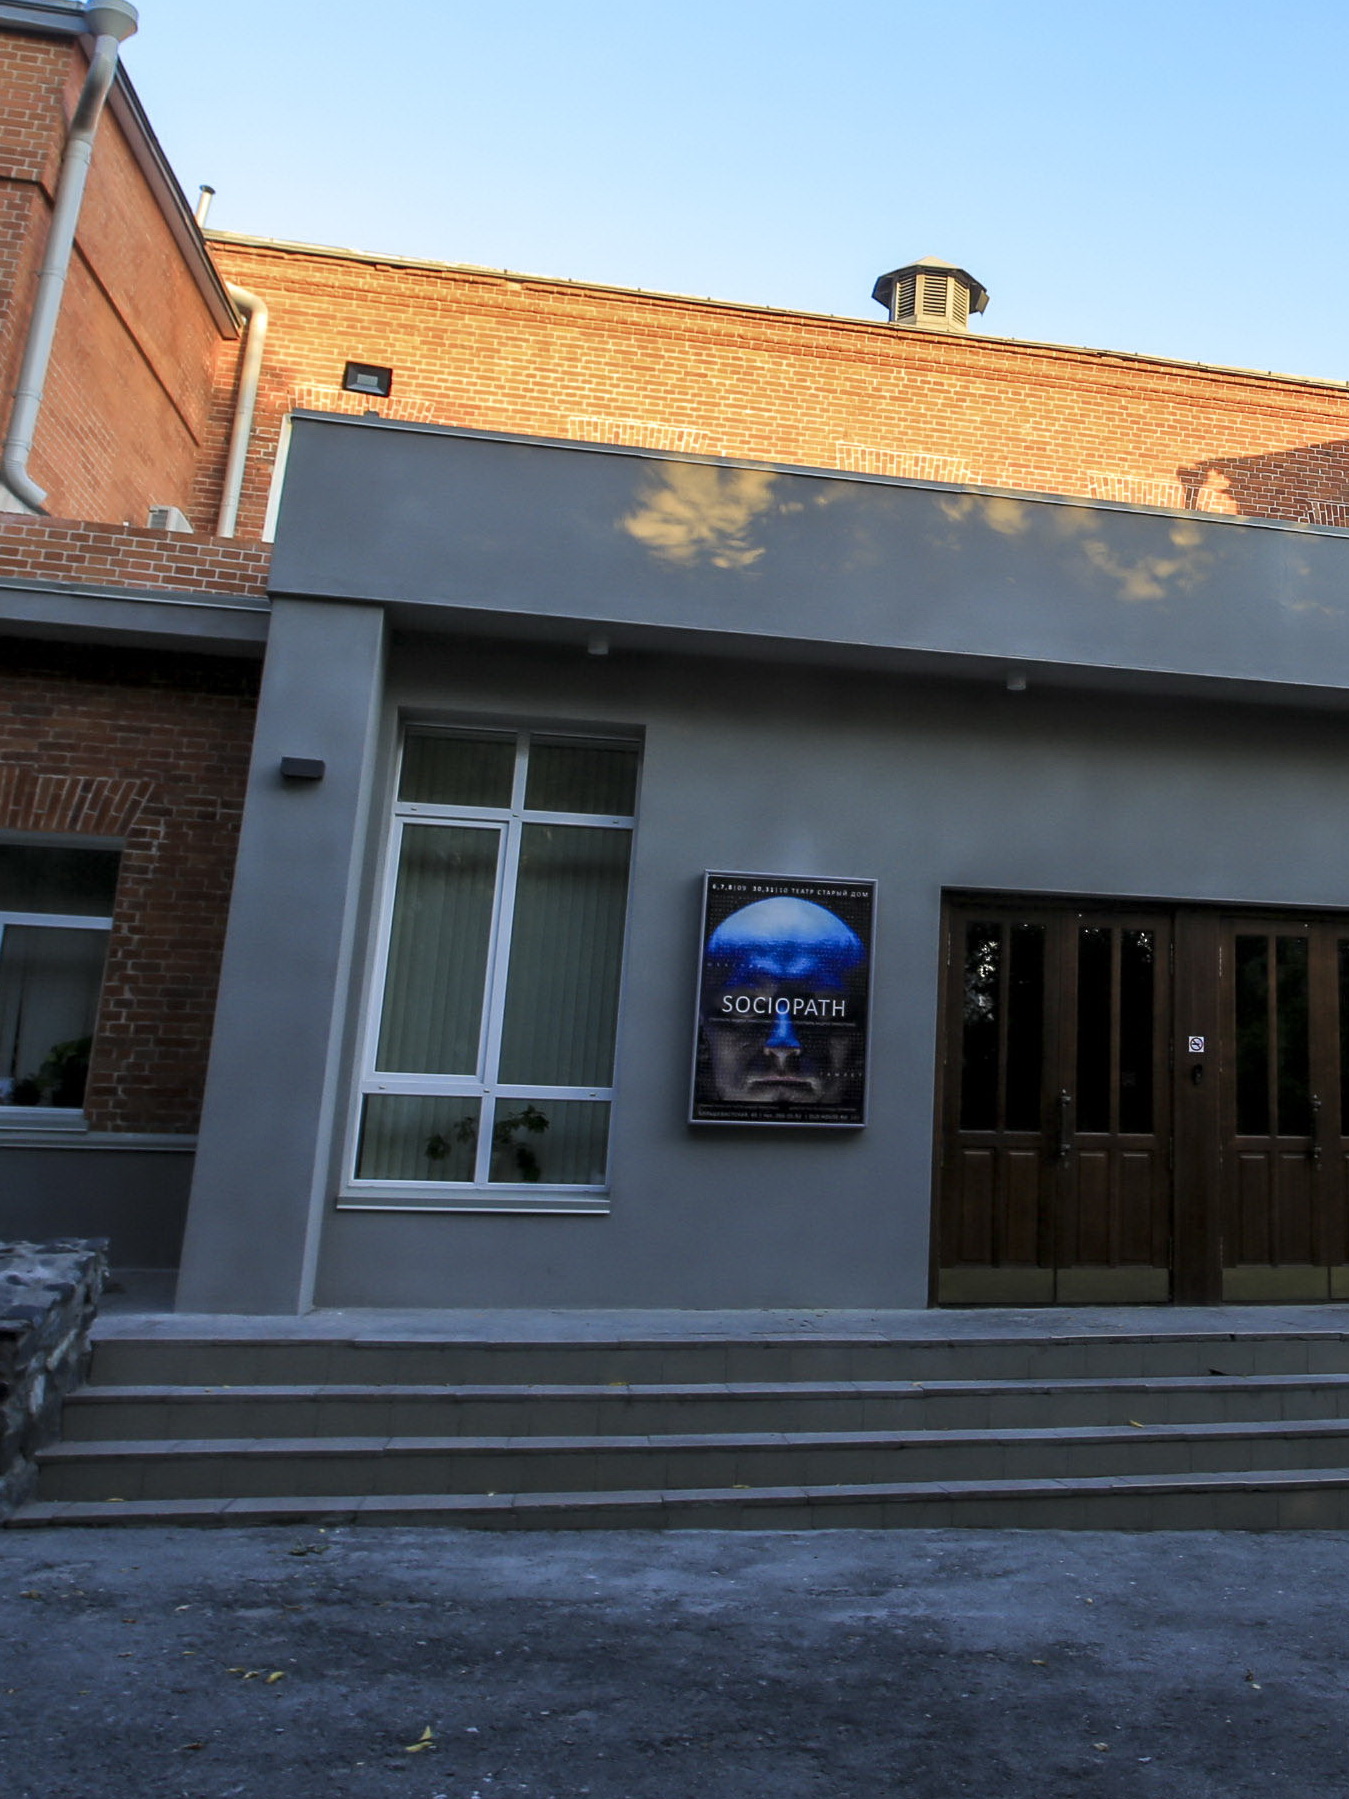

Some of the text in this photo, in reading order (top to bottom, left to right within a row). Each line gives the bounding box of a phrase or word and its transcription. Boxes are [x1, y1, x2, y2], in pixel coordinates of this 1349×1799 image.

[791, 887, 814, 895] ТЕАТР
[817, 889, 848, 897] СТАРЫЙ
[722, 995, 845, 1017] SOCIOPATH
